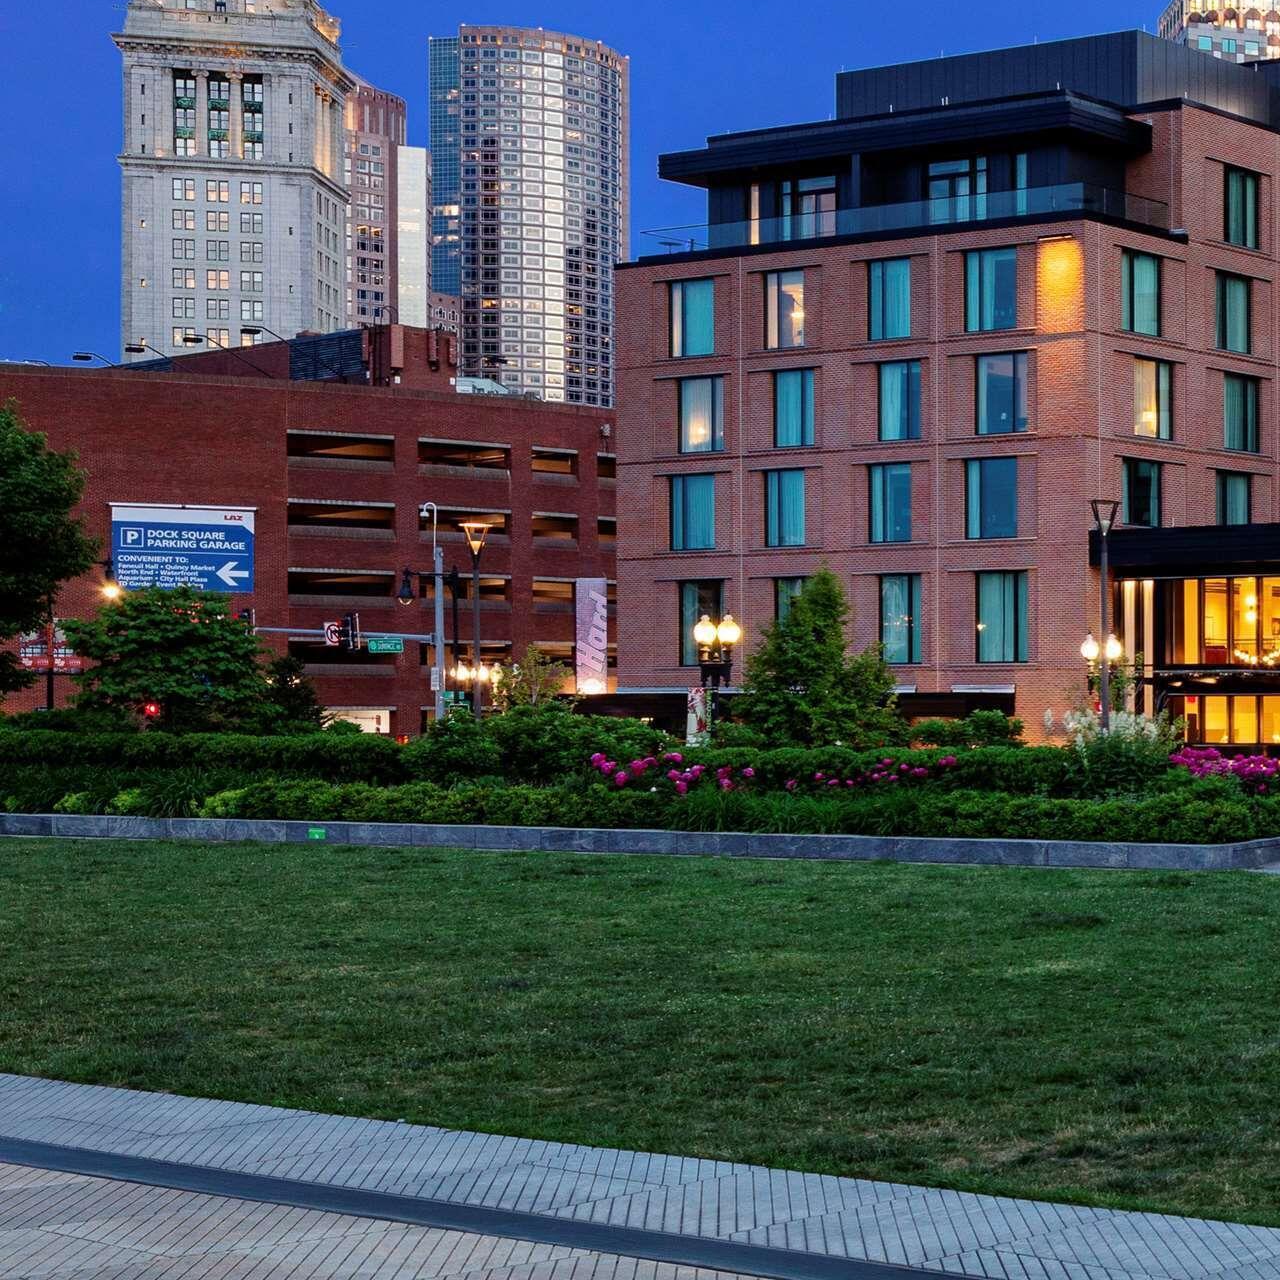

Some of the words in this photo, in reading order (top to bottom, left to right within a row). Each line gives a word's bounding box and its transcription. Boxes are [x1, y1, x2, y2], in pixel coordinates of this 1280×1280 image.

[126, 530, 139, 544] P
[147, 529, 179, 539] DOCK
[181, 530, 225, 540] SQUARE
[147, 539, 197, 549] PARKING
[199, 541, 246, 550] GARAGE
[117, 554, 174, 563] CONVENIENT
[175, 556, 189, 564] TO:
[118, 562, 144, 570] Faneuil
[165, 563, 189, 571] Quincy
[160, 575, 174, 583] City
